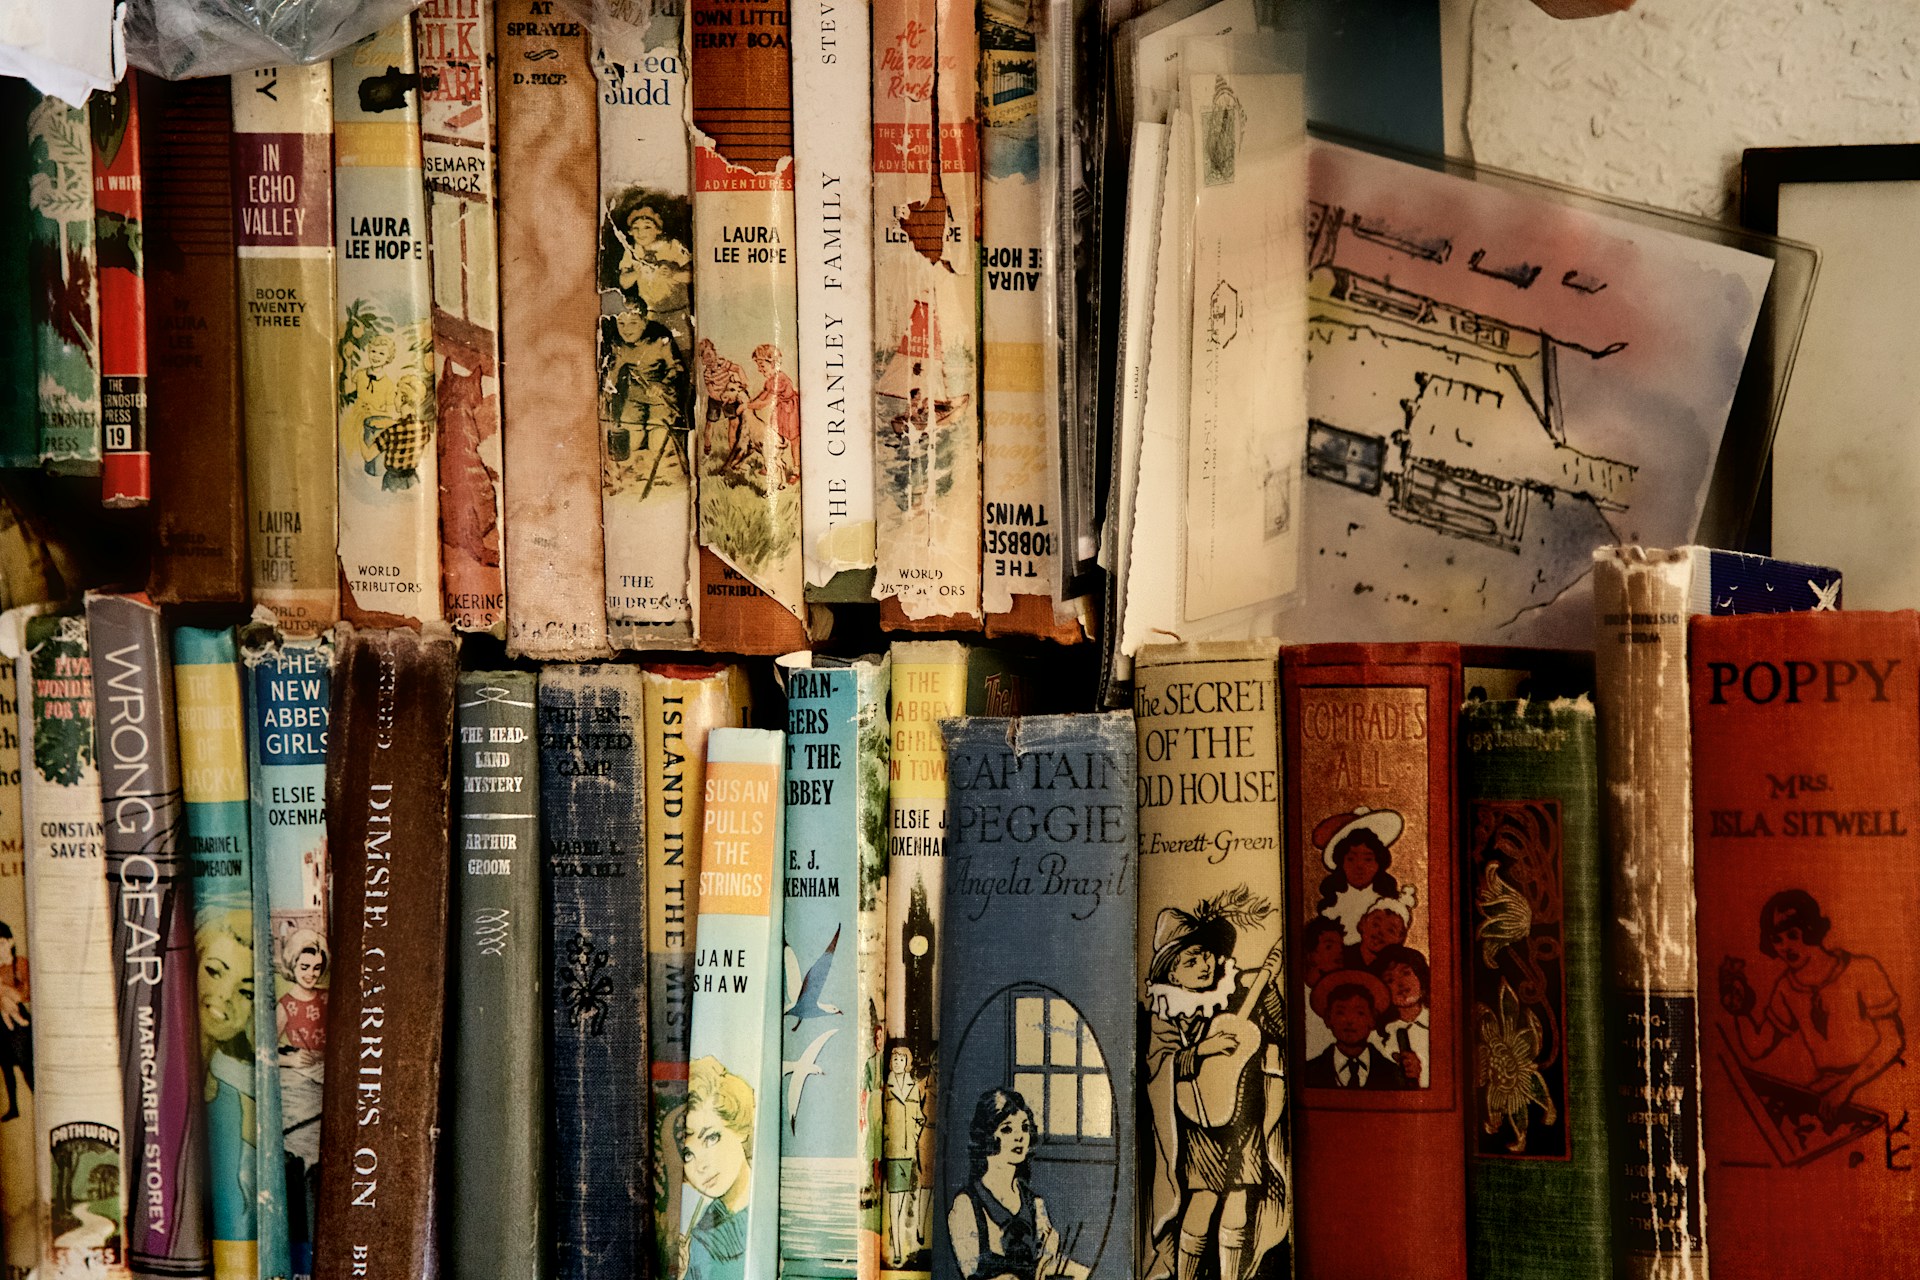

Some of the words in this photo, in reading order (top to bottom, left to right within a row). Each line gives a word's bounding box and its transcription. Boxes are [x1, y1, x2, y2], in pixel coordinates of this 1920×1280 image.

[530, 1, 553, 15] AT
[694, 10, 732, 25] OWN
[741, 10, 788, 25] LITTL
[507, 22, 580, 37] SPRAYLE
[821, 3, 837, 64] STEV
[419, 22, 478, 61] ILK
[694, 33, 737, 48] FERRY
[748, 33, 786, 48] BOA
[604, 78, 671, 105] Judd
[879, 129, 895, 138] THE
[263, 144, 279, 172] IN
[423, 157, 486, 173] SEMARY
[249, 175, 296, 203] ECHO
[424, 176, 481, 192] ATRICK
[243, 208, 306, 236] VALLEY
[351, 217, 410, 236] LAURA
[822, 172, 842, 290] FAMILY
[723, 226, 780, 243] LAURA
[346, 240, 369, 259] LEE
[376, 241, 422, 259] HOPE
[714, 247, 740, 263] LEE
[748, 248, 787, 264] HOPE
[987, 272, 1041, 291] AURA
[255, 289, 297, 300] BOOK
[249, 302, 307, 314] TWENTY
[255, 315, 301, 327] THREE
[108, 379, 123, 392] THE
[824, 313, 847, 457] CRANLEY
[104, 394, 147, 407] ERNOSTER
[105, 409, 131, 422] PRESS
[45, 437, 79, 451] PRESS
[109, 428, 125, 446] 19
[829, 478, 847, 528] HE
[258, 511, 302, 534] LAURA
[987, 502, 1048, 527] TWINS
[266, 536, 293, 559] LEE
[261, 560, 297, 583] HOPE
[358, 565, 400, 577] WORLD
[996, 560, 1038, 577] THE
[349, 581, 422, 593] STRIBUTORS
[620, 576, 654, 588] THE
[268, 606, 306, 618] ORLD
[447, 594, 504, 611] CKERING
[276, 654, 317, 675] THE
[271, 680, 320, 701] NEW
[788, 672, 839, 698] TRAN-
[907, 671, 940, 693] THE
[1707, 659, 1901, 706] POPPY
[1135, 687, 1161, 718] The
[1164, 680, 1273, 716] SECRET
[45, 701, 74, 719] FOR
[180, 705, 236, 730] ORTUNES
[264, 706, 329, 728] ABBEY
[895, 701, 954, 722] ABBEY
[1302, 702, 1427, 741] COMRADES
[104, 643, 155, 833] WRONG
[461, 727, 483, 744] THE
[488, 727, 529, 744] HEAD-
[1146, 730, 1179, 762] OF
[1184, 726, 1256, 760] THE
[475, 752, 510, 768] LAND
[556, 759, 611, 776] CAMP
[662, 696, 685, 819] ISLAND
[804, 744, 842, 770] THE
[910, 760, 948, 781] TOW
[951, 751, 1138, 791] CAPTAIN
[1335, 751, 1390, 793] ALL
[272, 787, 315, 803] ELSIE
[464, 777, 523, 793] MYSTERY
[705, 779, 770, 803] SUSAN
[1180, 770, 1277, 806] HOUSE
[269, 809, 327, 825] OXENHA
[704, 810, 763, 834] PULLS
[894, 809, 931, 829] ELSIE
[956, 804, 1127, 845] PEGGIE
[1710, 809, 1776, 838] ISLA
[1783, 808, 1908, 838] SITWELL
[41, 822, 104, 837] CONSTAN
[190, 836, 231, 853] THARINE
[465, 834, 517, 850] ARTHUR
[664, 833, 685, 868] IN
[1151, 829, 1279, 865] Everett-Green
[364, 783, 393, 928] DIMSIE
[714, 841, 749, 865] THE
[789, 851, 801, 870] E.
[807, 850, 820, 870] J.
[468, 859, 511, 876] GROOM
[699, 871, 763, 897] STRINGS
[784, 877, 840, 897] XENHAM
[949, 856, 1034, 922] Angela
[1037, 852, 1130, 921] Brazil
[119, 855, 163, 987] GEAR
[664, 879, 685, 948] THE
[696, 949, 746, 967] JANE
[692, 975, 748, 993] SHAW
[666, 963, 687, 1047] MIST
[358, 947, 386, 1127] CARRIES
[137, 1006, 161, 1136] MARGARET
[52, 1123, 118, 1146] PATHWAY
[351, 1147, 378, 1208] ON
[143, 1144, 165, 1234] STOREY
